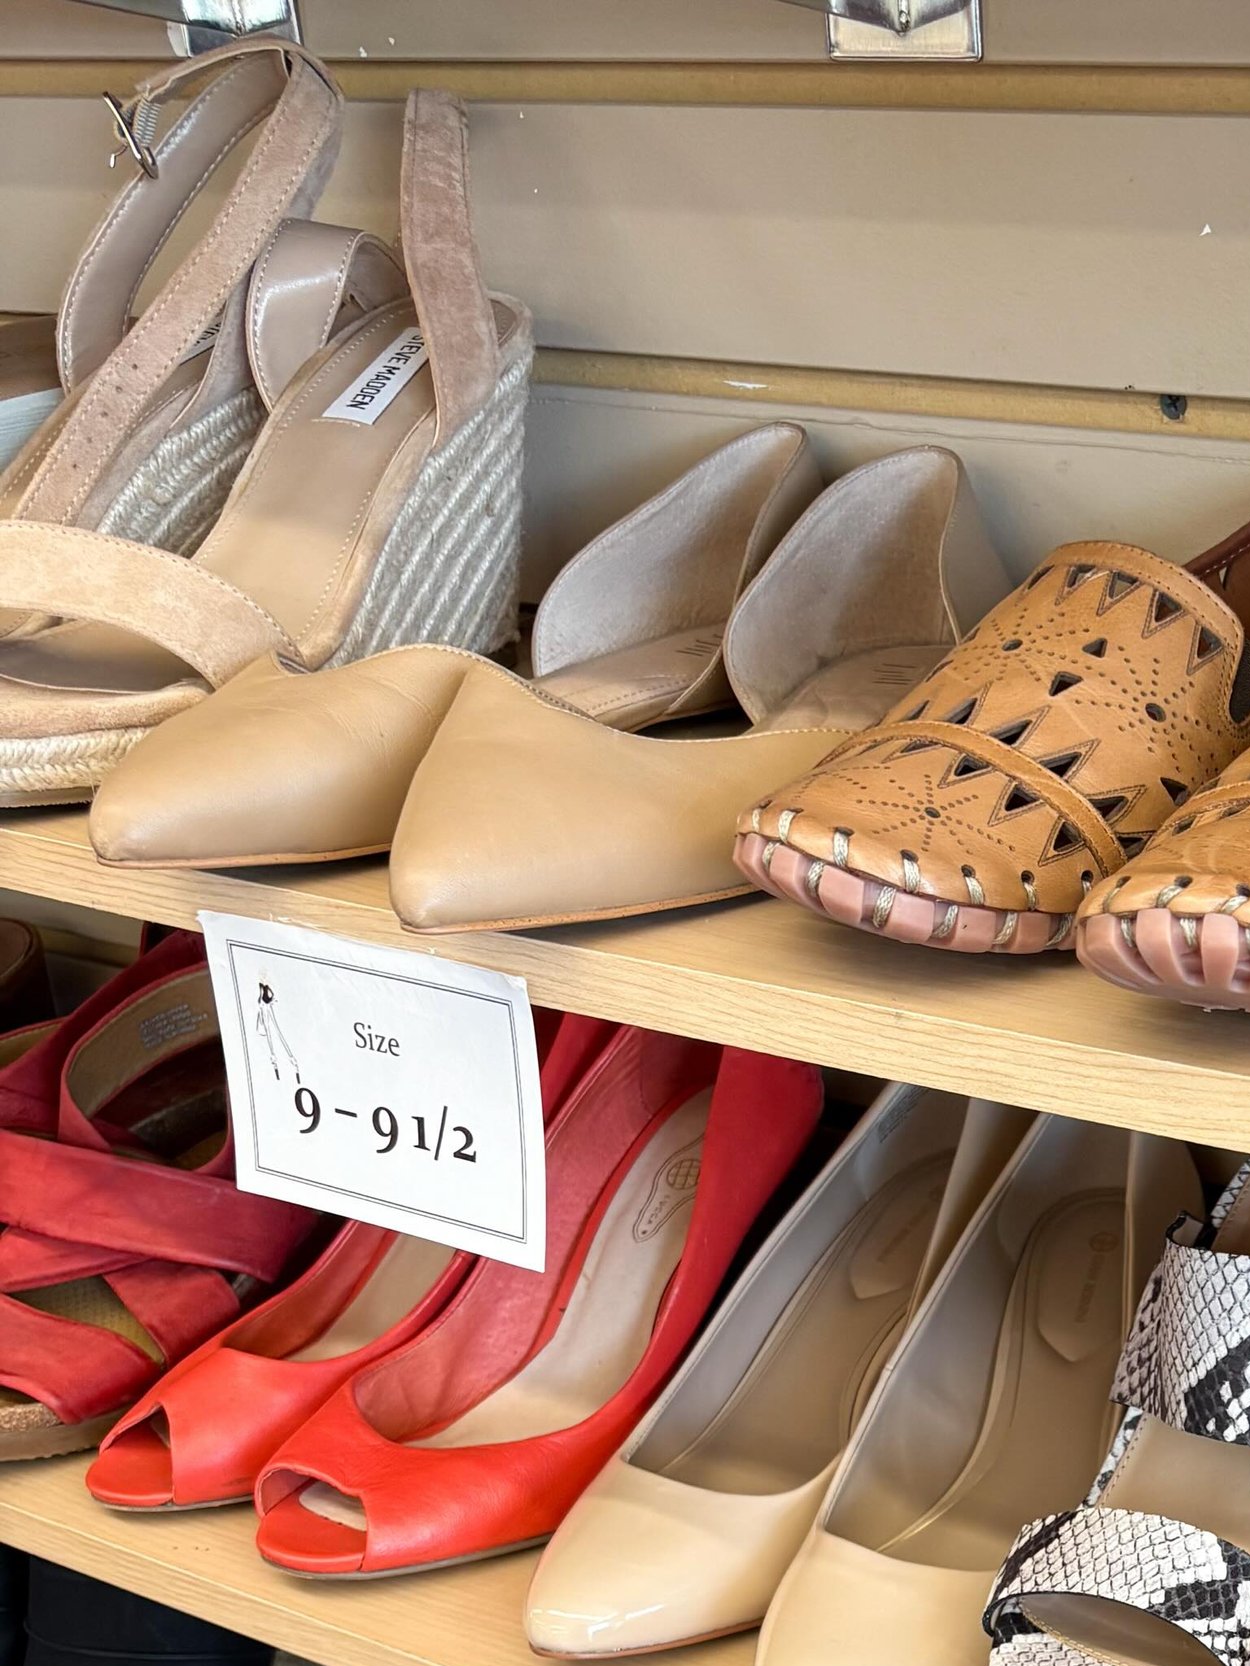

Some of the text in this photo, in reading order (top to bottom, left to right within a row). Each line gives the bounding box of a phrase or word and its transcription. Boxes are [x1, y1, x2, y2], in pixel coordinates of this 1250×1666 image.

[346, 334, 425, 411] STEVE MADDEN
[353, 1021, 401, 1057] Size
[294, 1087, 321, 1134] 9
[371, 1106, 399, 1154] 9
